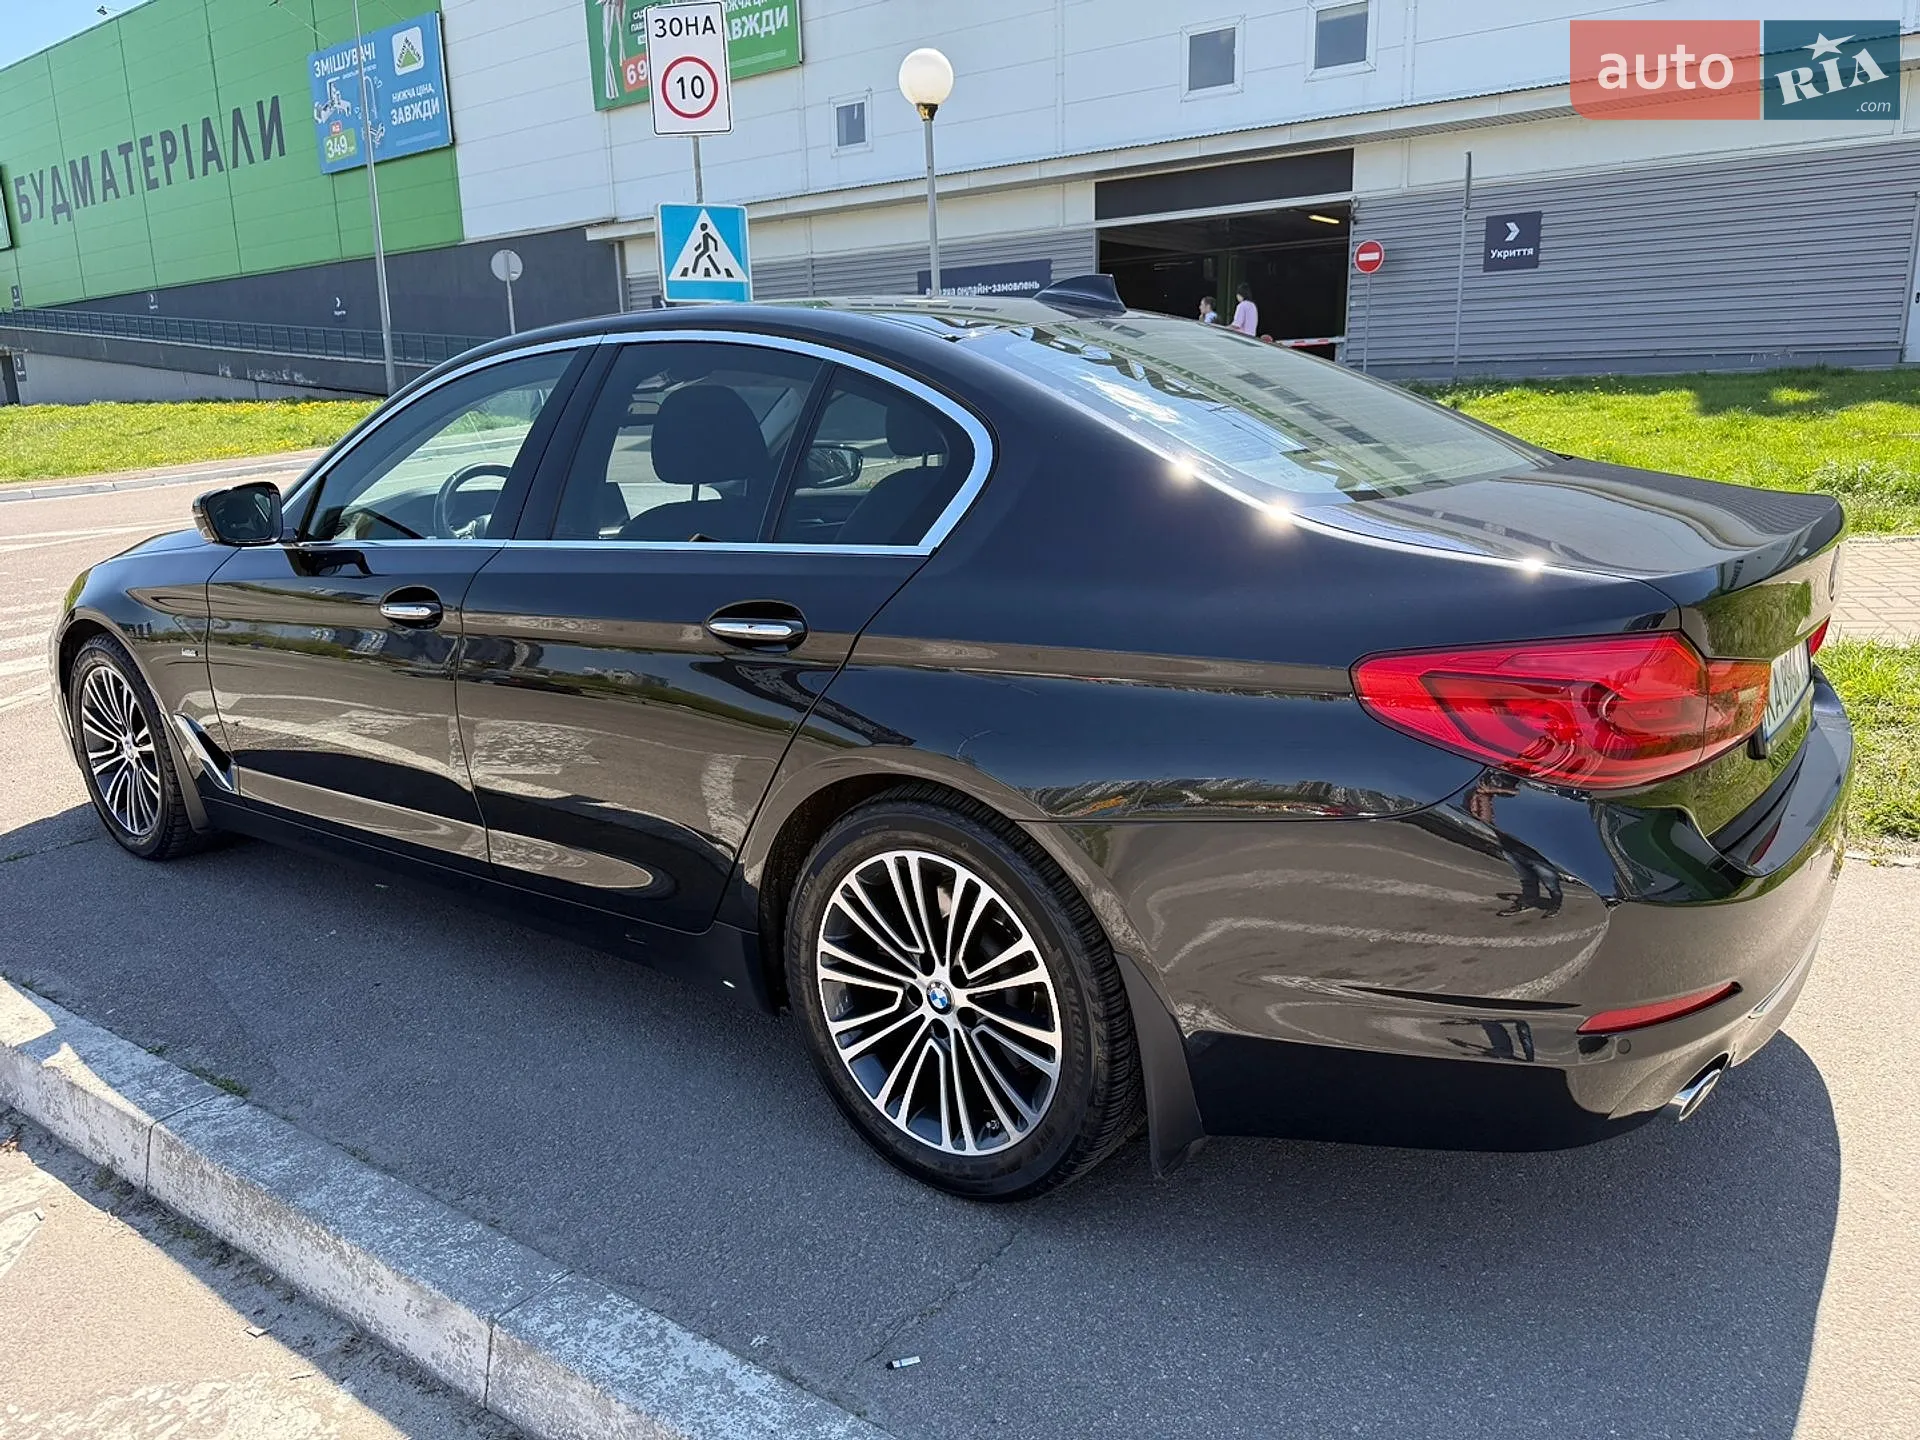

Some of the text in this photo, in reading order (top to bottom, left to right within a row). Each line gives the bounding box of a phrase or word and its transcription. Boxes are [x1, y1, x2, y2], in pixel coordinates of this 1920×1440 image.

[654, 15, 717, 38] ЗОНА
[676, 75, 705, 99] 10
[390, 96, 440, 126] ЗАВЖДИ
[326, 135, 348, 158] 349
[14, 95, 286, 225] БУДМАТЕРІАЛИ
[1490, 248, 1534, 260] Укриття
